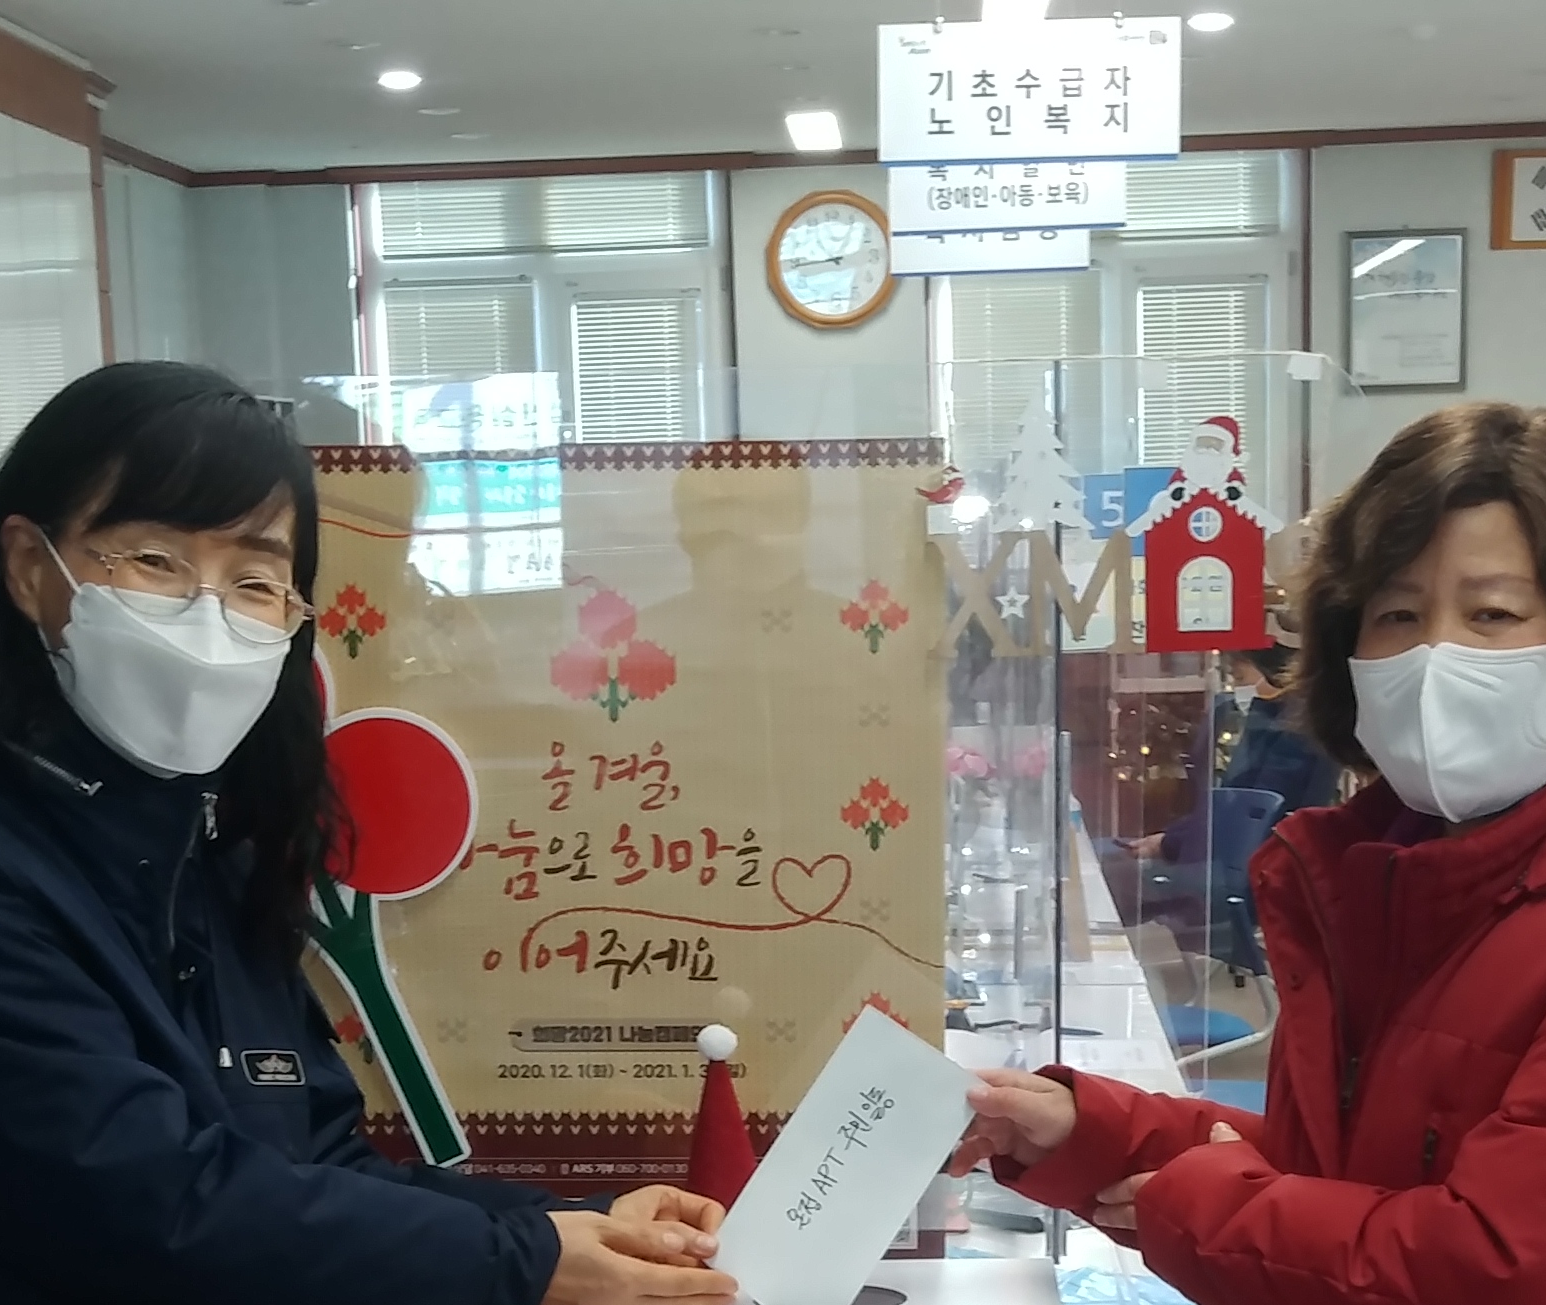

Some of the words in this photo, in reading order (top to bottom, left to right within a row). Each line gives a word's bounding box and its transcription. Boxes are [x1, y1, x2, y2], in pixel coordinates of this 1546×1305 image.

[928, 66, 1131, 101] 기초수급자
[927, 102, 1129, 136] 노인복지
[542, 741, 575, 811] 올
[611, 824, 762, 888] 희망을
[483, 928, 718, 989] 이어주세요
[810, 1147, 845, 1196] APT
